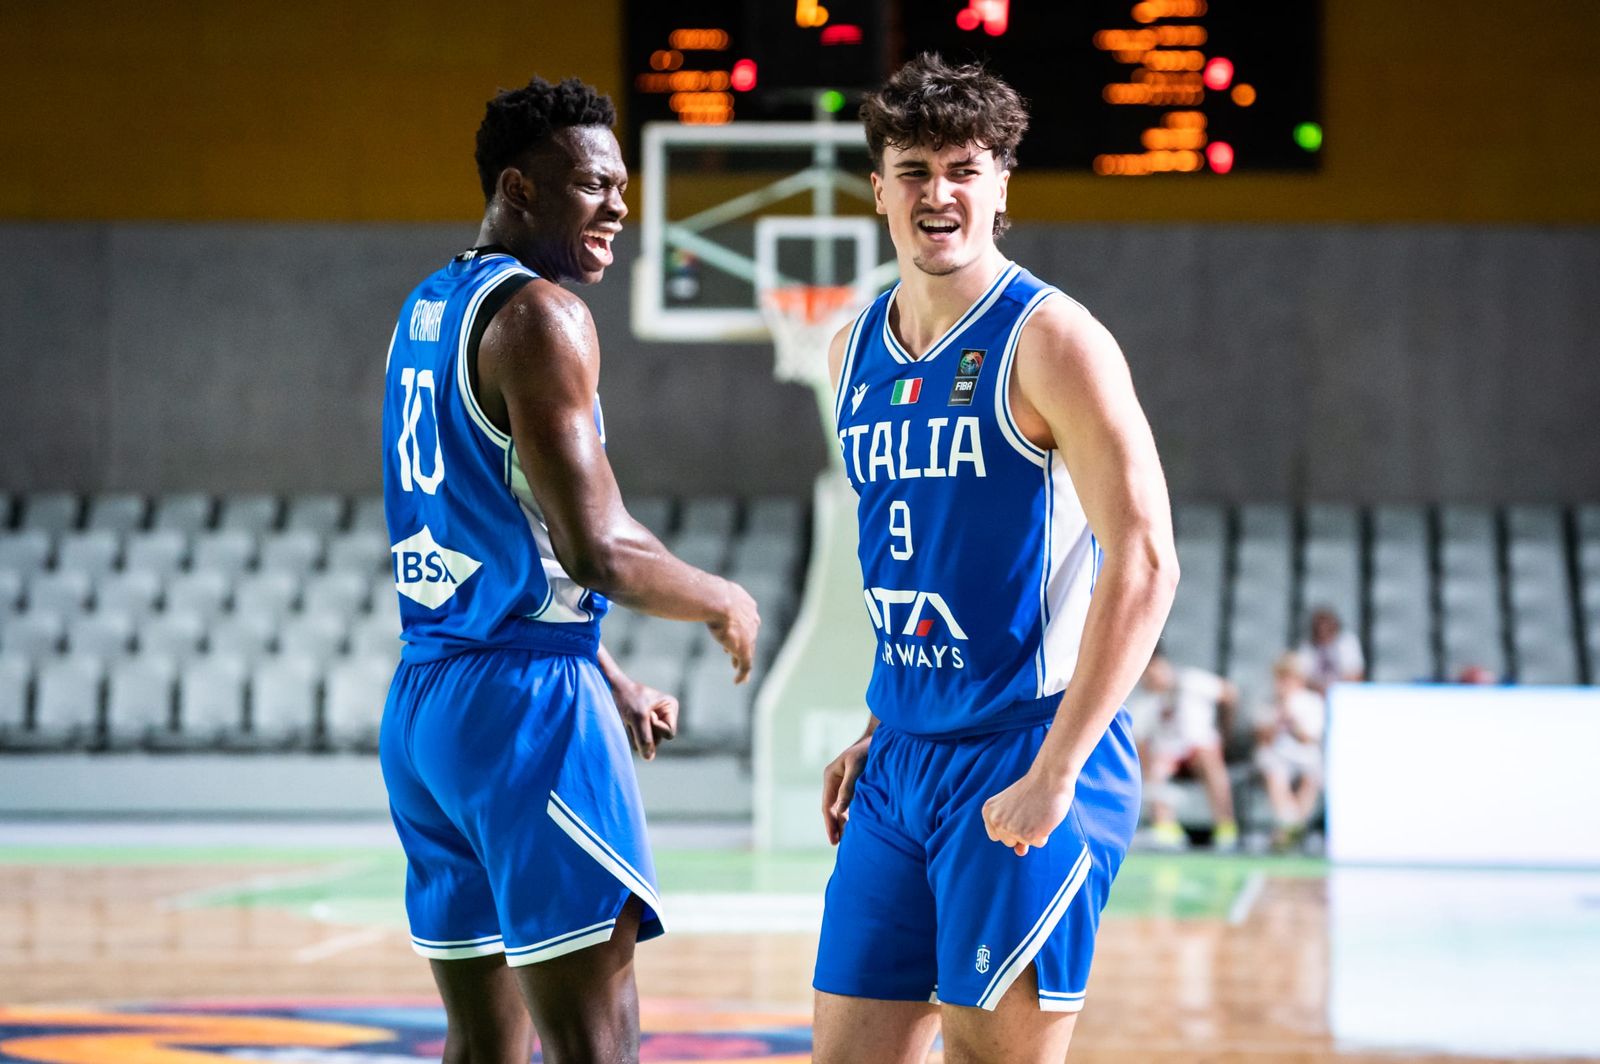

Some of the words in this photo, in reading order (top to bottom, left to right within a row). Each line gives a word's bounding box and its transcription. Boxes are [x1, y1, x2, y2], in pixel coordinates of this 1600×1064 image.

[955, 381, 973, 391] FIBA
[398, 368, 445, 495] 10
[889, 500, 914, 561] 9
[882, 640, 965, 669] RWAYS
